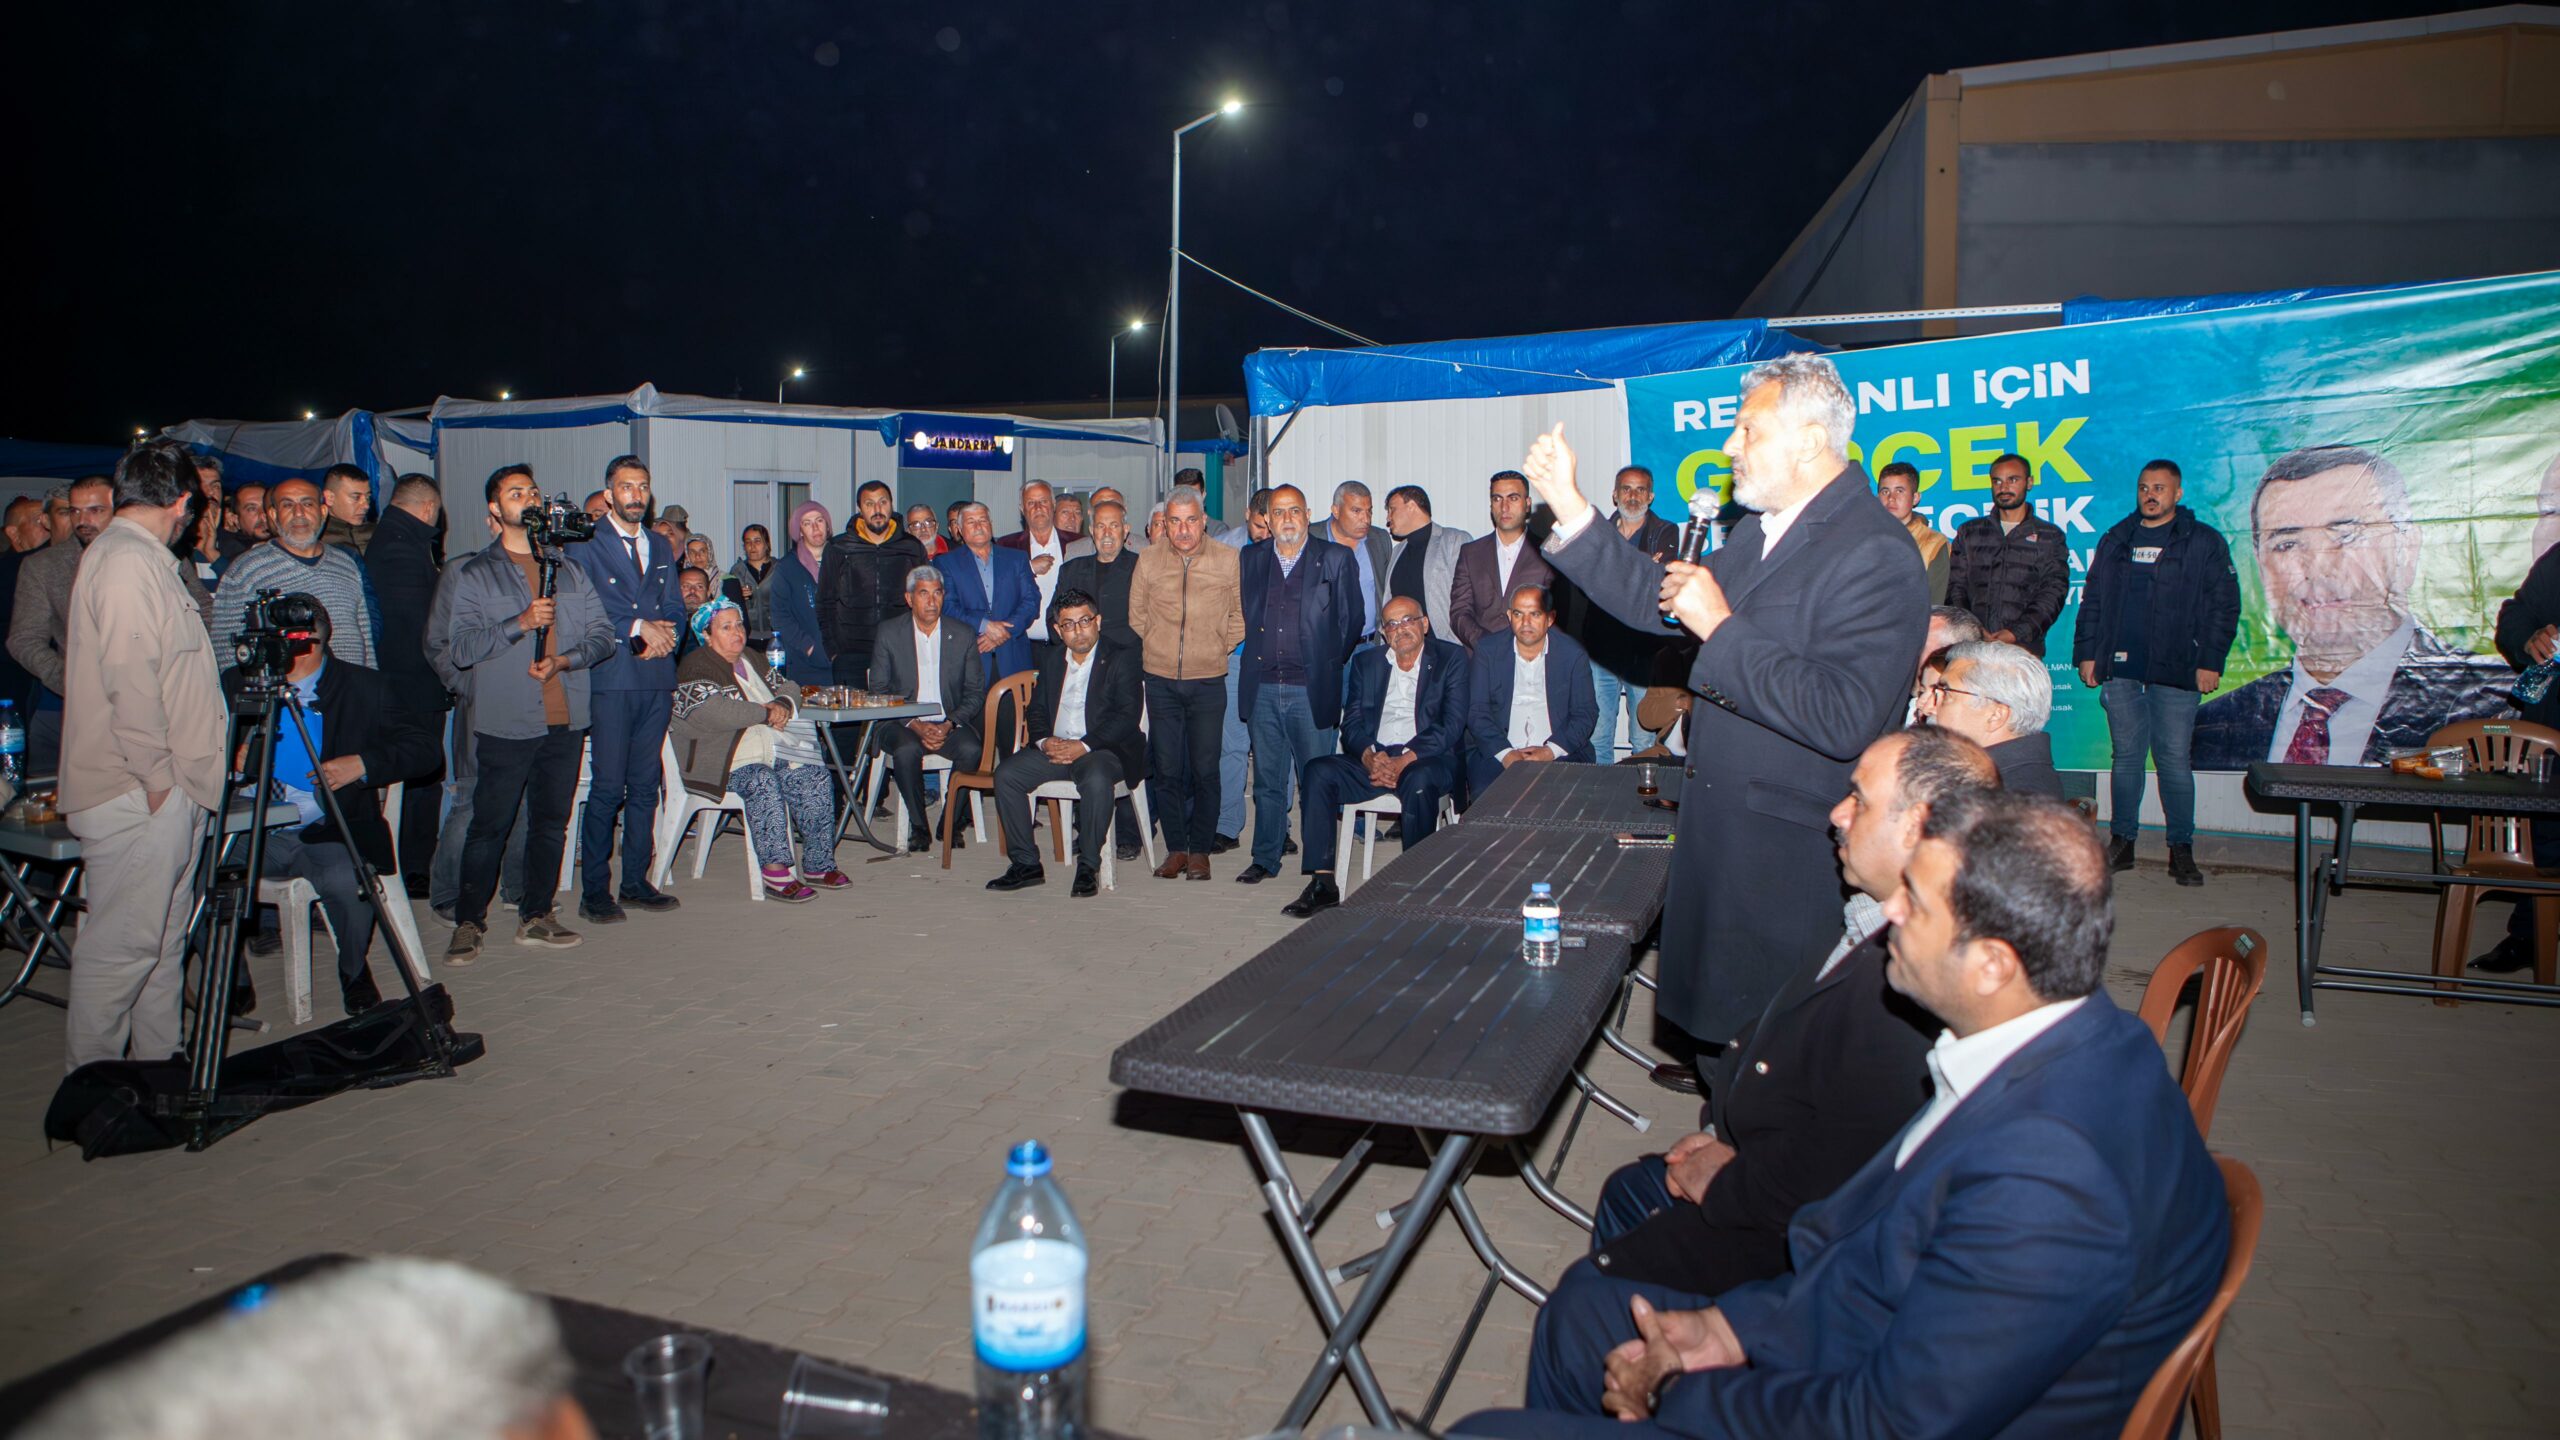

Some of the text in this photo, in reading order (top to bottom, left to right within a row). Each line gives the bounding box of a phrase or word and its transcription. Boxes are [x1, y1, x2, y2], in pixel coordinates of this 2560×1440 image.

[1673, 358, 2090, 432] RENLI İÇİN
[931, 437, 996, 451] JANDARMA
